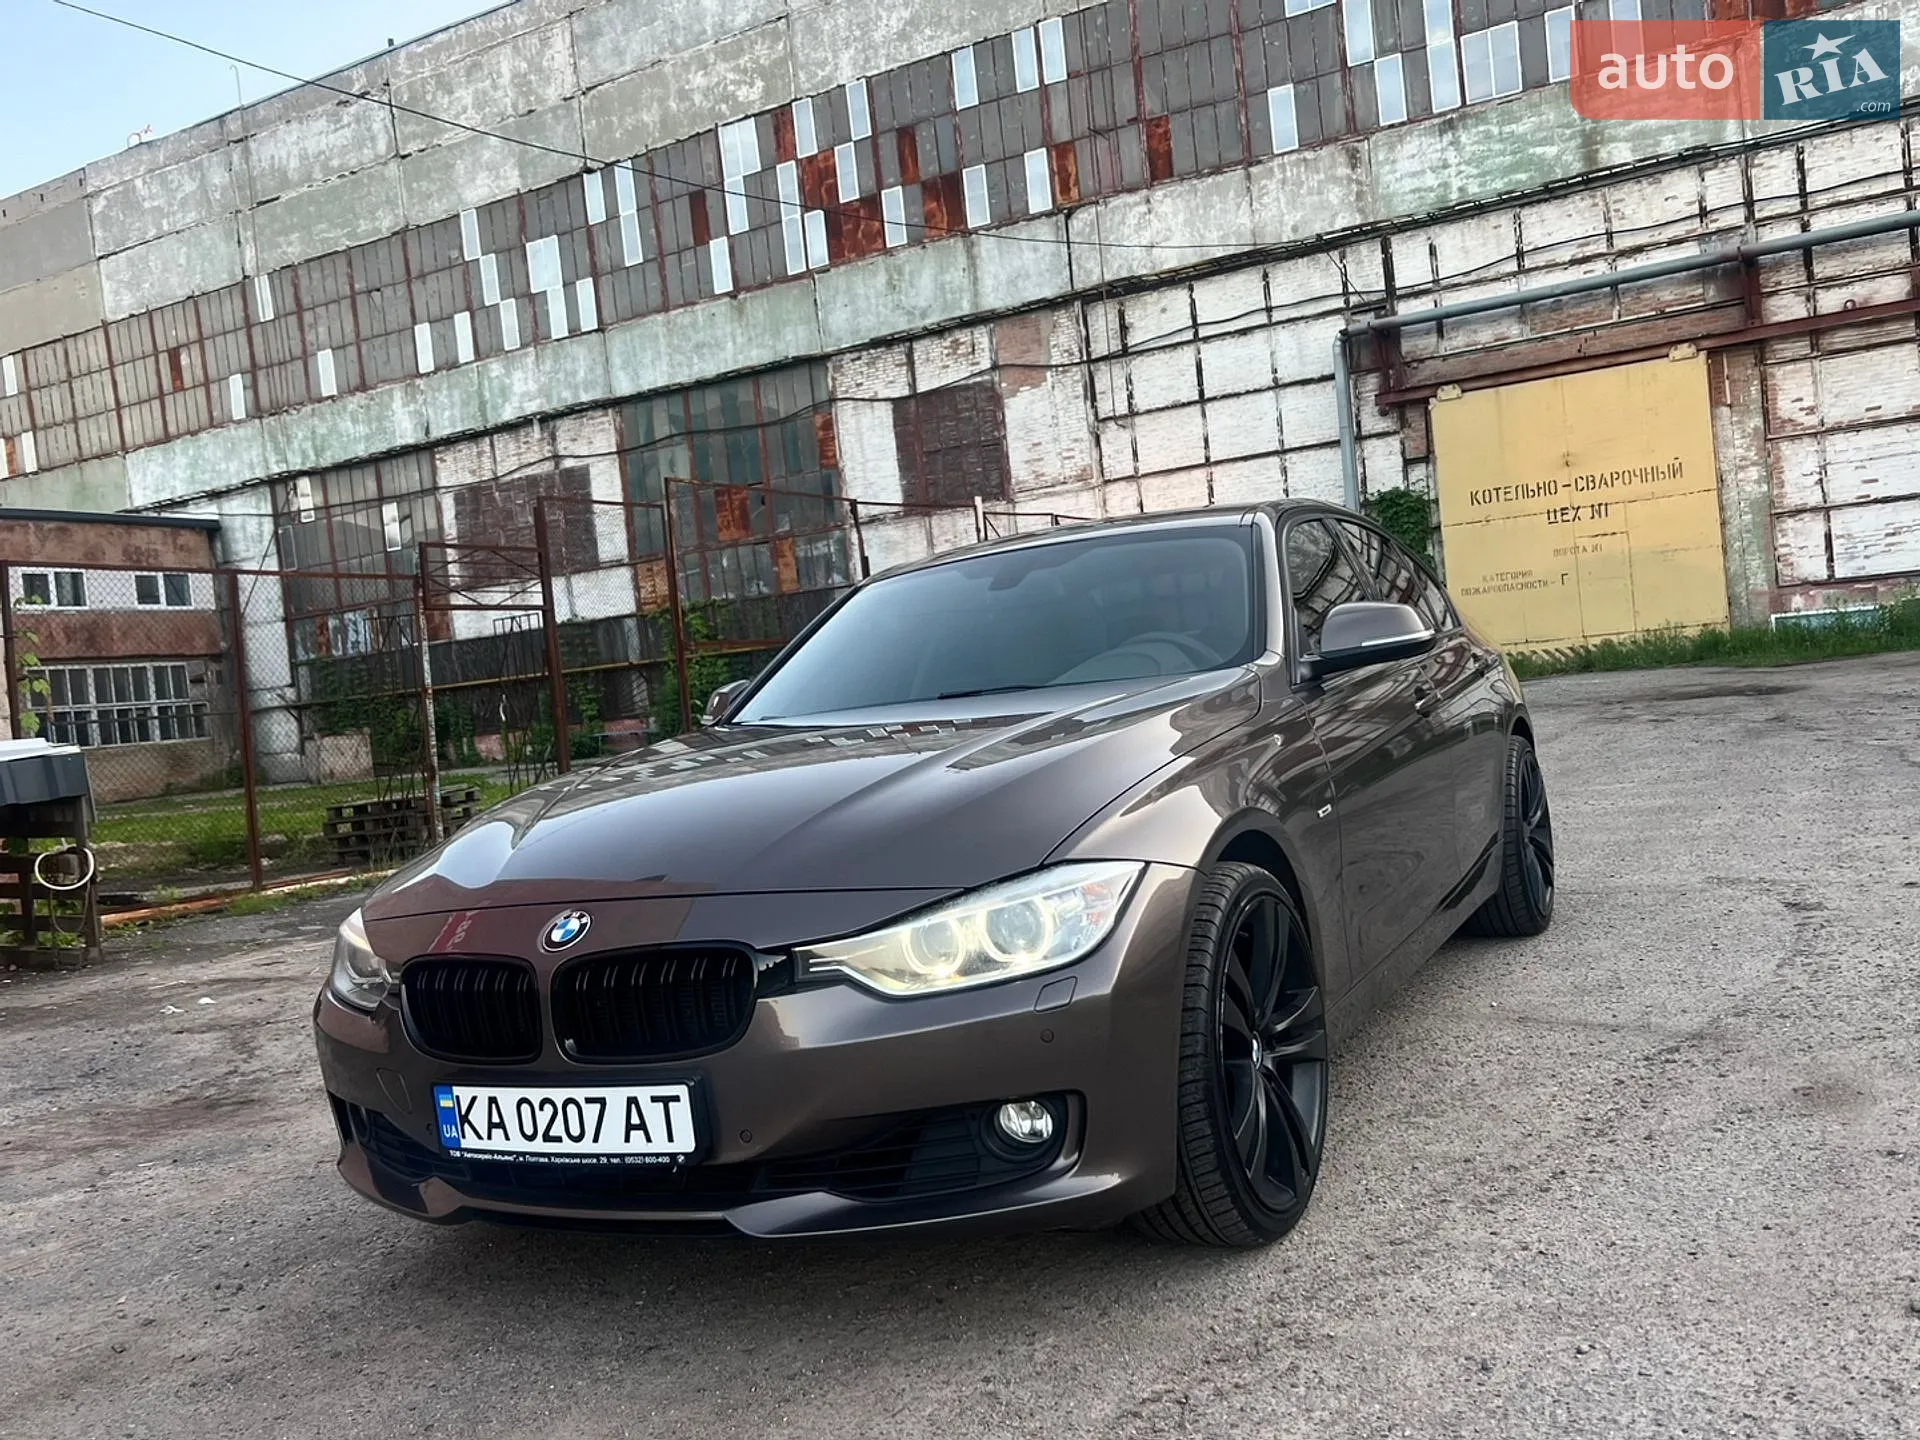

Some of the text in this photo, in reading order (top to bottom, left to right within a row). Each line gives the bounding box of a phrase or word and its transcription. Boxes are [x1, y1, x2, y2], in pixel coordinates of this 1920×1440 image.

[1546, 505, 1581, 525] ЦЕХ
[1561, 573, 1569, 586] Г
[516, 1096, 607, 1143] 0207
[442, 1124, 459, 1138] UA
